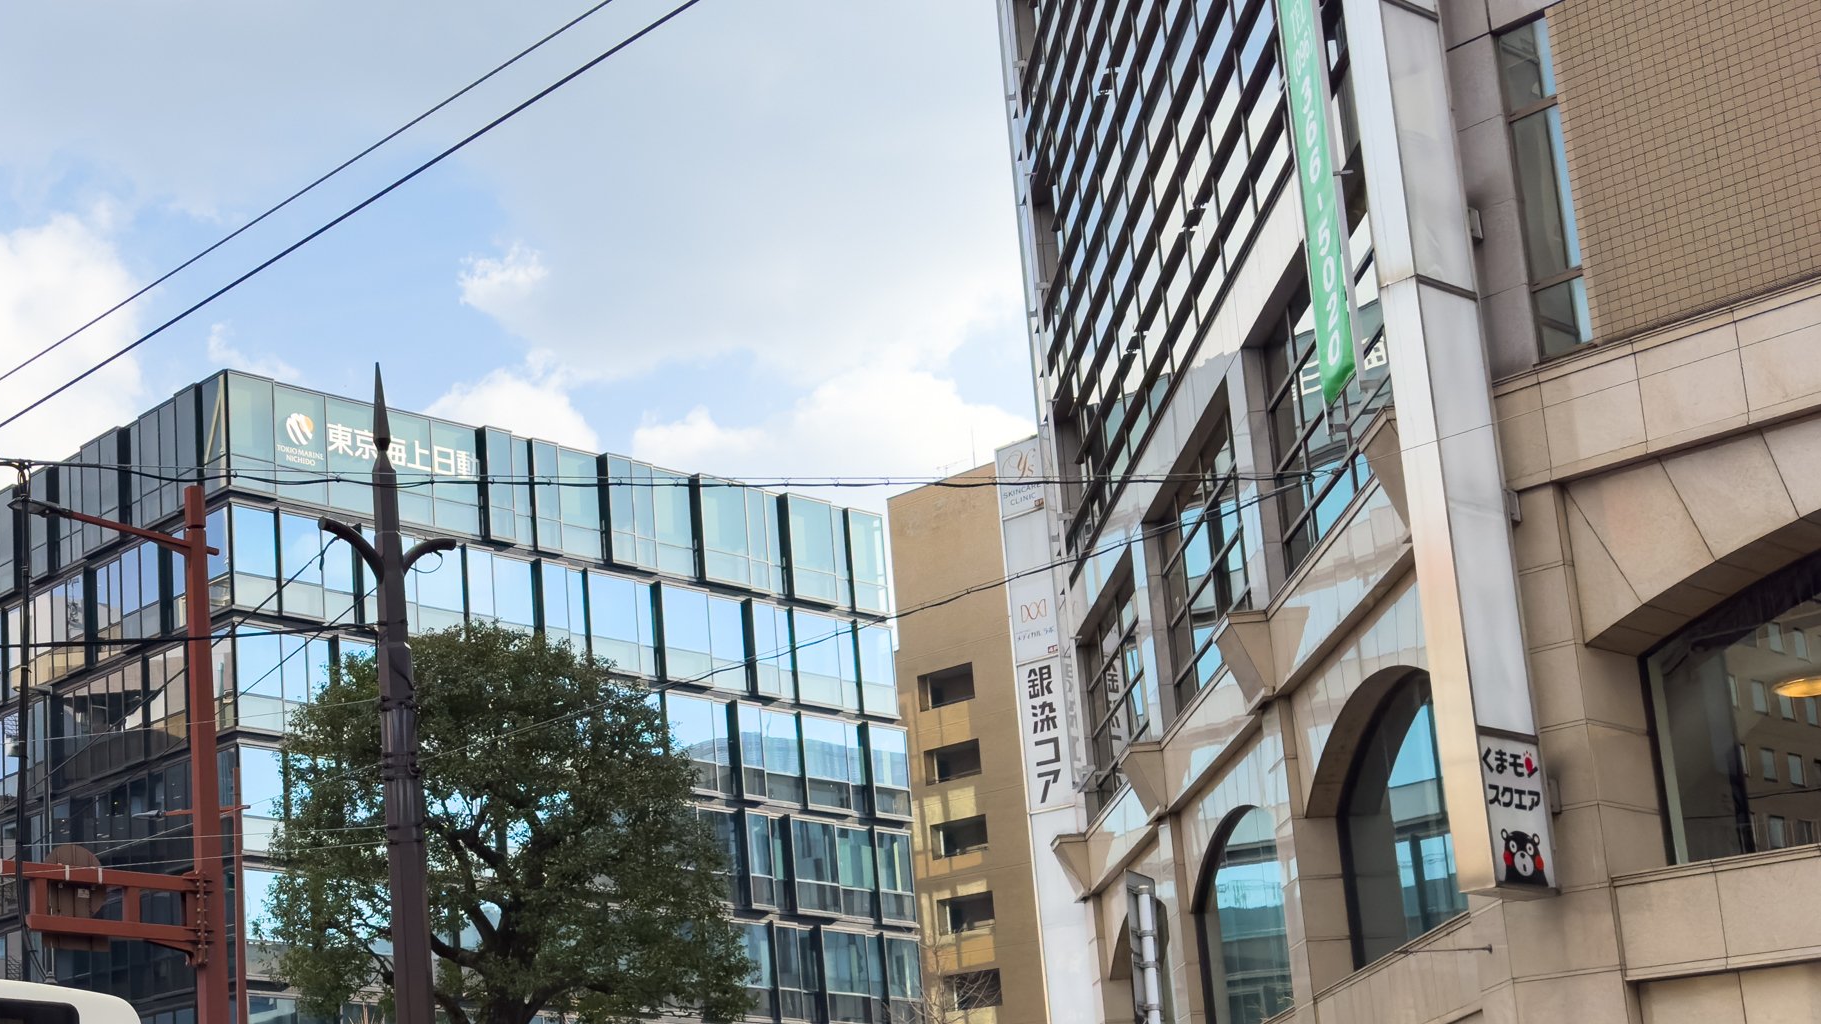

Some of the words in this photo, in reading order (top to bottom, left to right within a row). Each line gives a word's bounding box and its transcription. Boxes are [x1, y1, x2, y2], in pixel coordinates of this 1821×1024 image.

[276, 444, 298, 454] TOKIO
[297, 448, 324, 461] MARINE
[285, 455, 316, 467] NICHIDO
[326, 423, 480, 480] 東京海上日動
[1010, 492, 1036, 506] CLINIC
[1027, 664, 1062, 803] 銀染コア
[1488, 783, 1541, 811] スクエア
